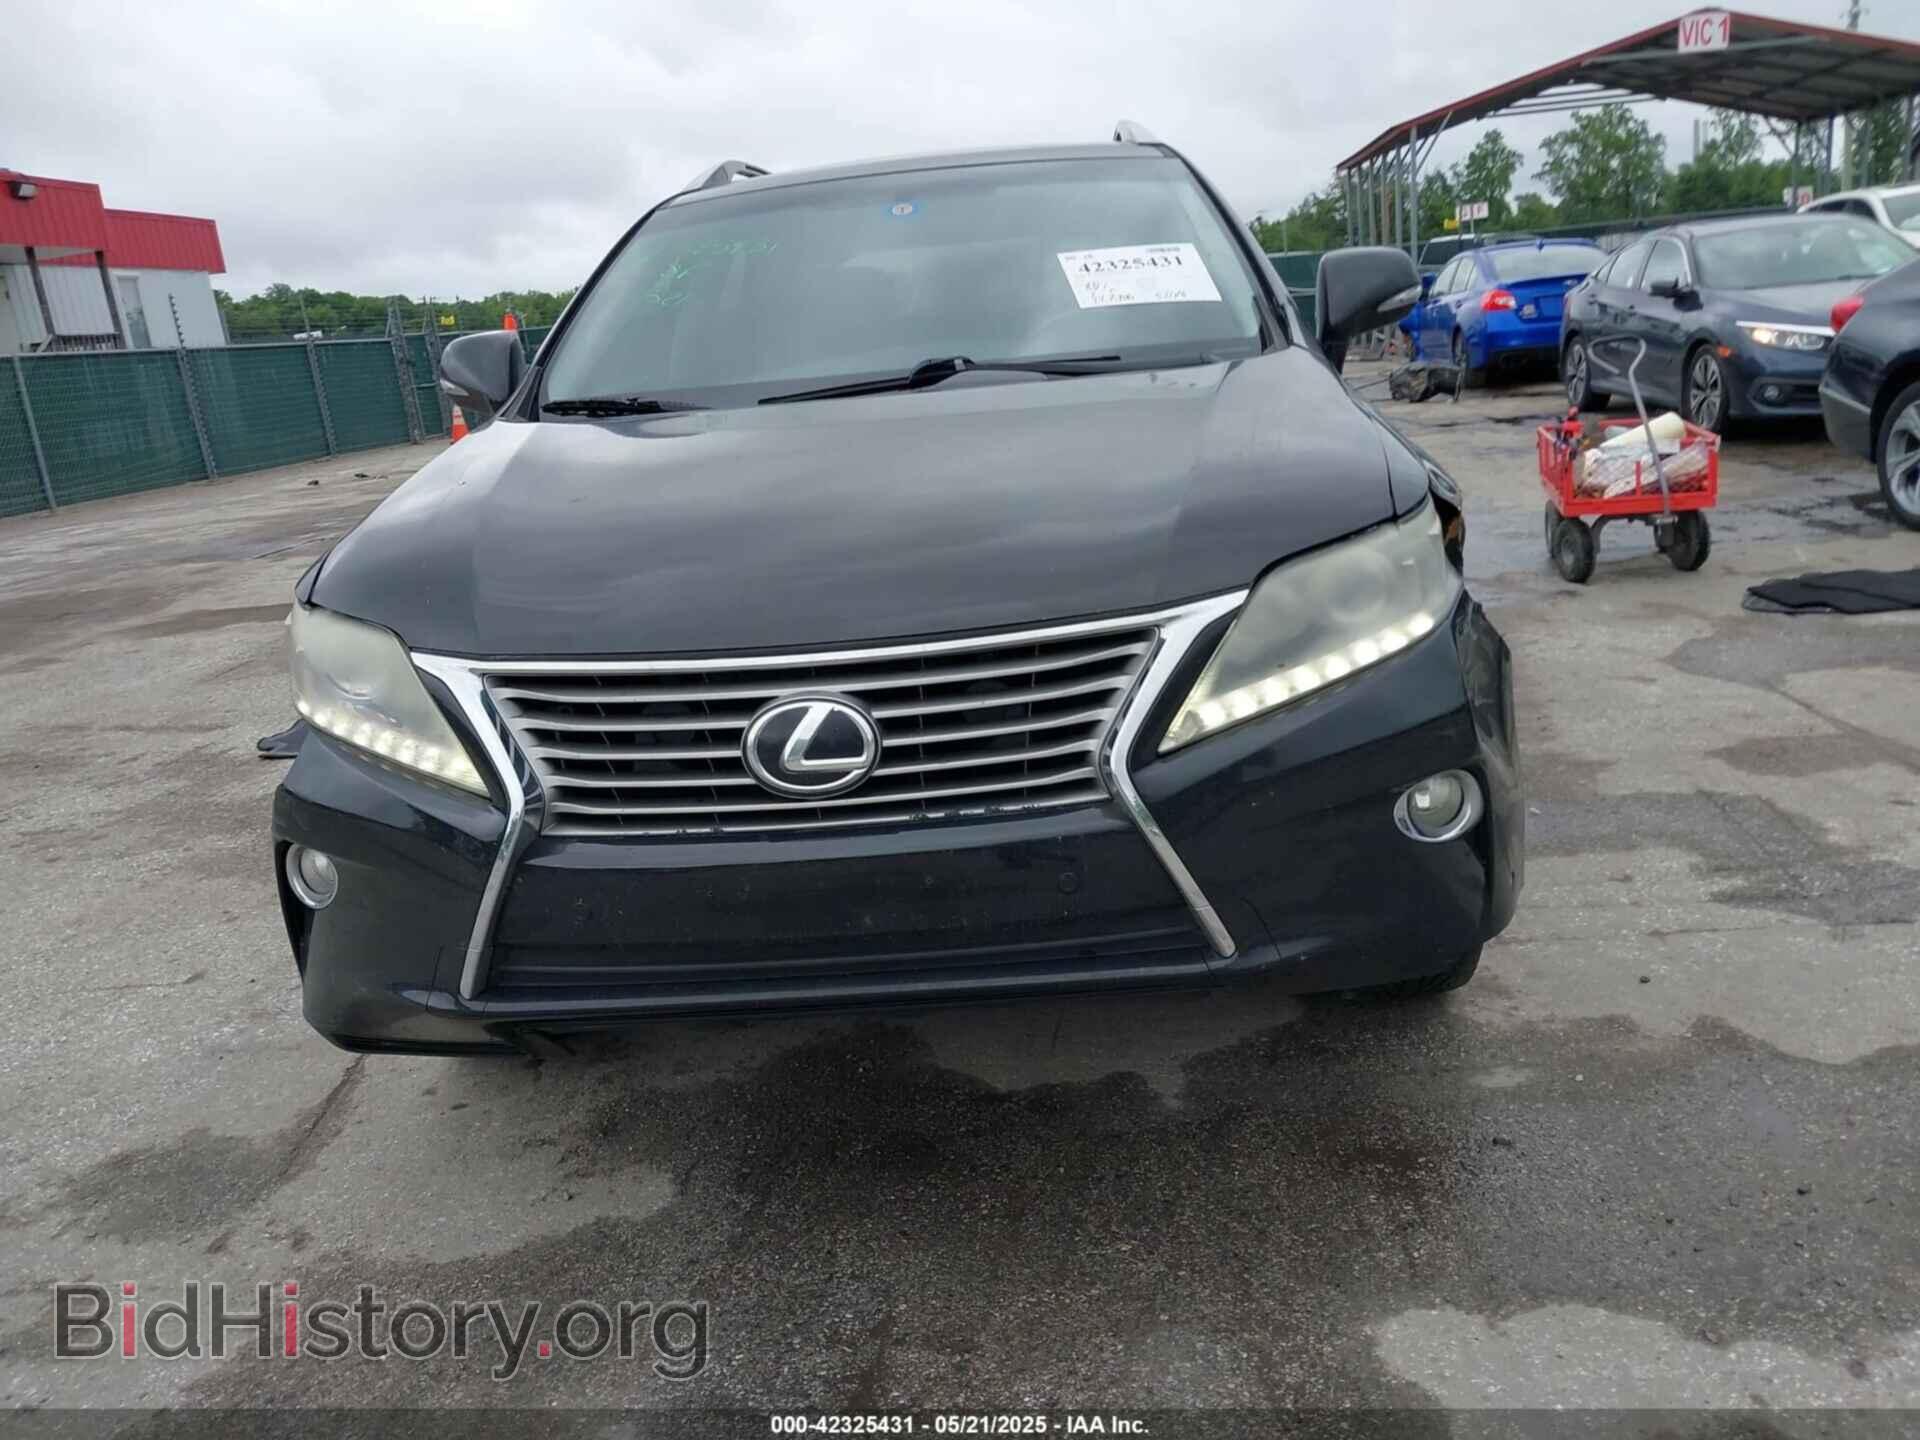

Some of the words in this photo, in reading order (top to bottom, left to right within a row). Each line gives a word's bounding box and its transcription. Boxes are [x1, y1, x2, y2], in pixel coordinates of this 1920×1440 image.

[1682, 18, 1712, 46] VIC
[1718, 16, 1729, 43] 1
[1079, 255, 1183, 273] 42325431
